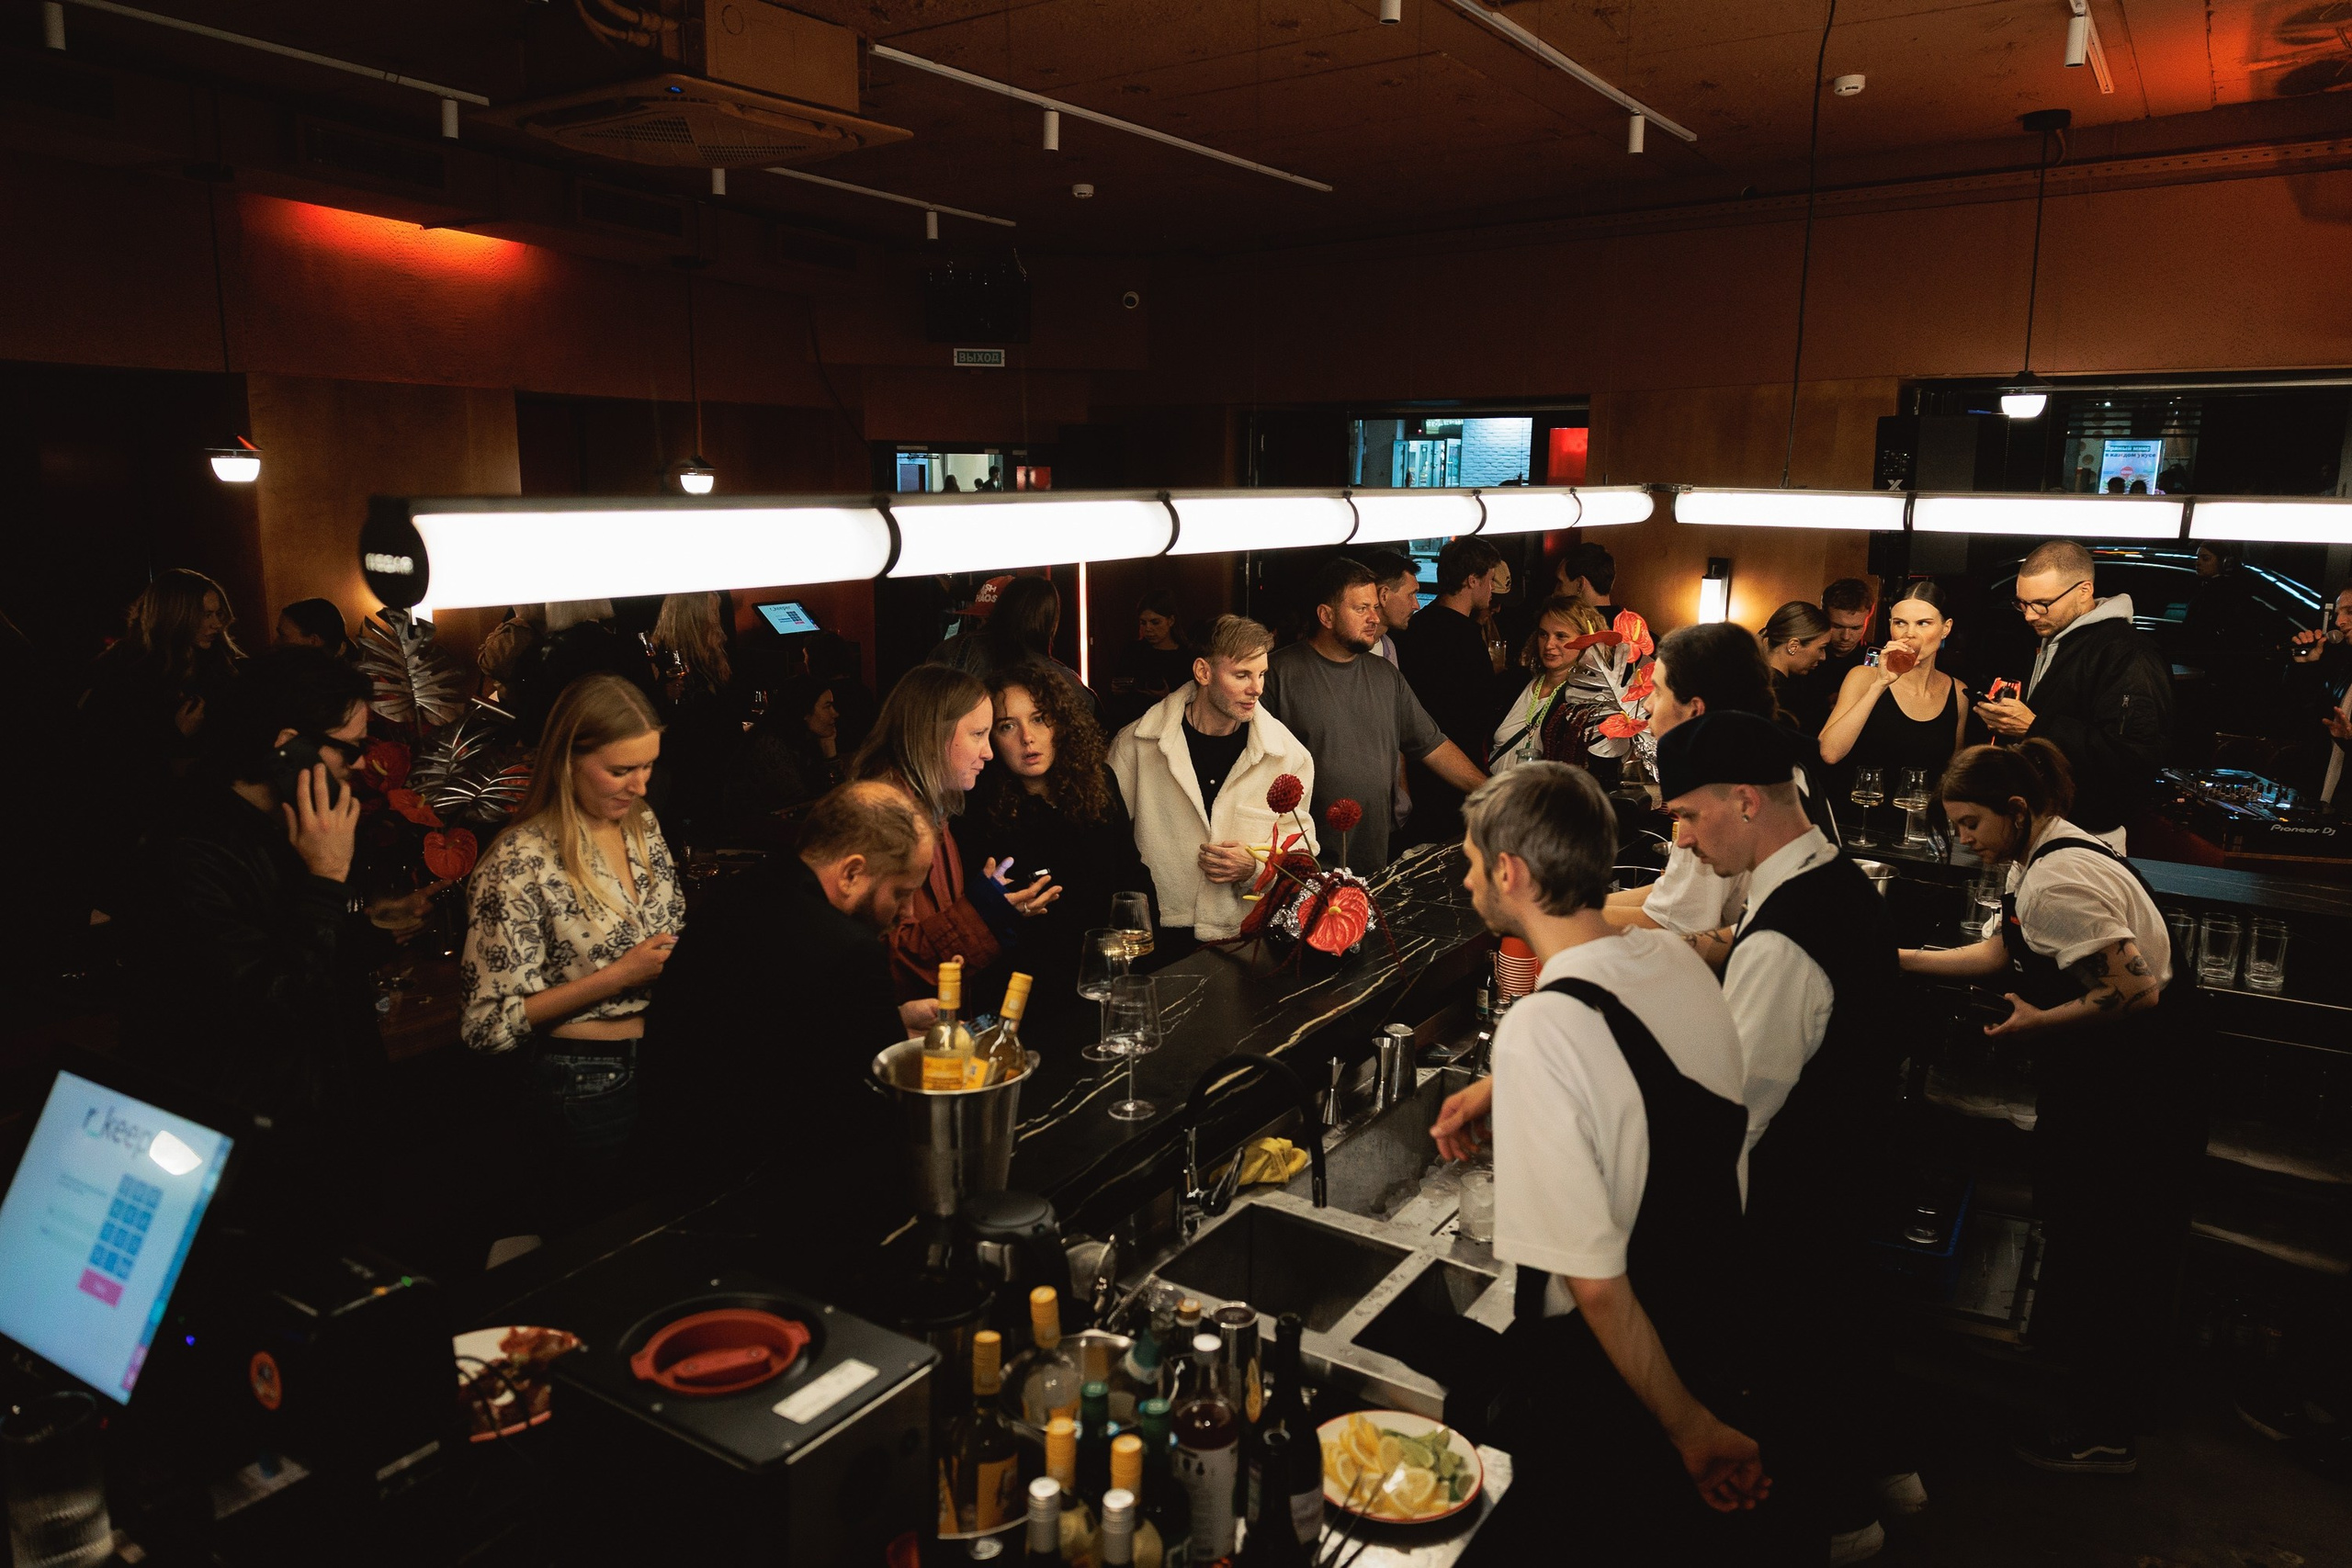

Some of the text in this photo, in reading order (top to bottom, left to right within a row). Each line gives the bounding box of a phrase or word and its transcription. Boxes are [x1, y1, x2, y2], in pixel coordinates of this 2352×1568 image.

[958, 353, 1000, 363] ВЫХОД
[975, 593, 998, 604] HAOS
[2270, 823, 2320, 834] Pioneer
[82, 1105, 152, 1159] r_keep
